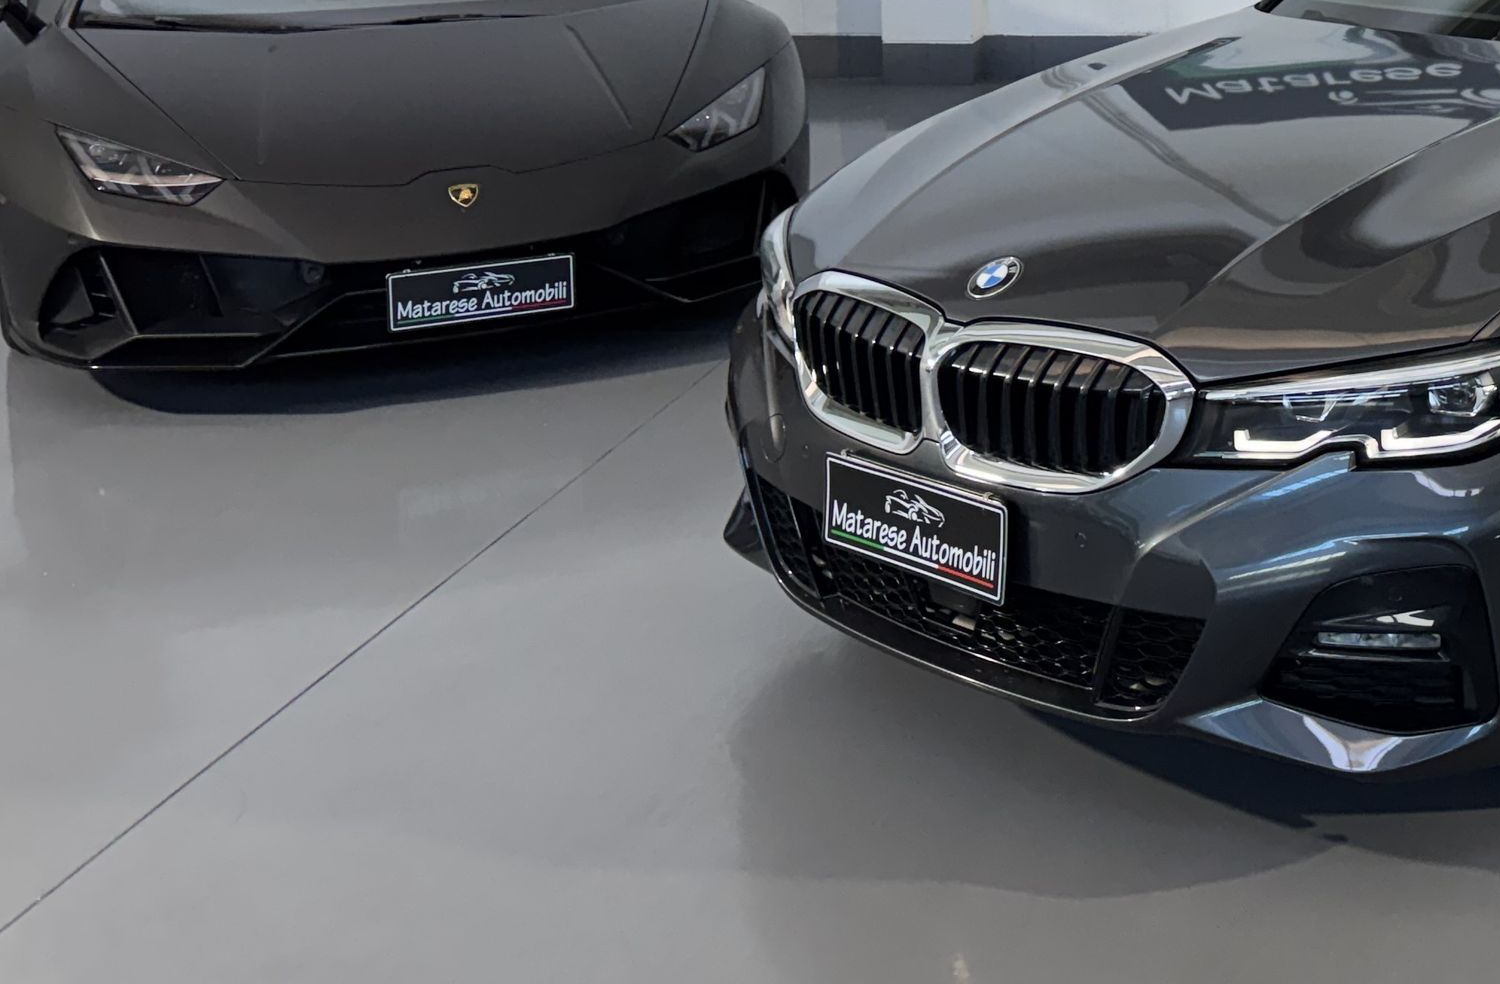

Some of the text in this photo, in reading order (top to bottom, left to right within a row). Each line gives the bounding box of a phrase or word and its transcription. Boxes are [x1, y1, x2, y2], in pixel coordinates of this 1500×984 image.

[396, 280, 569, 321] Matarese Automobili
[831, 499, 997, 582] Matarese Automobili
